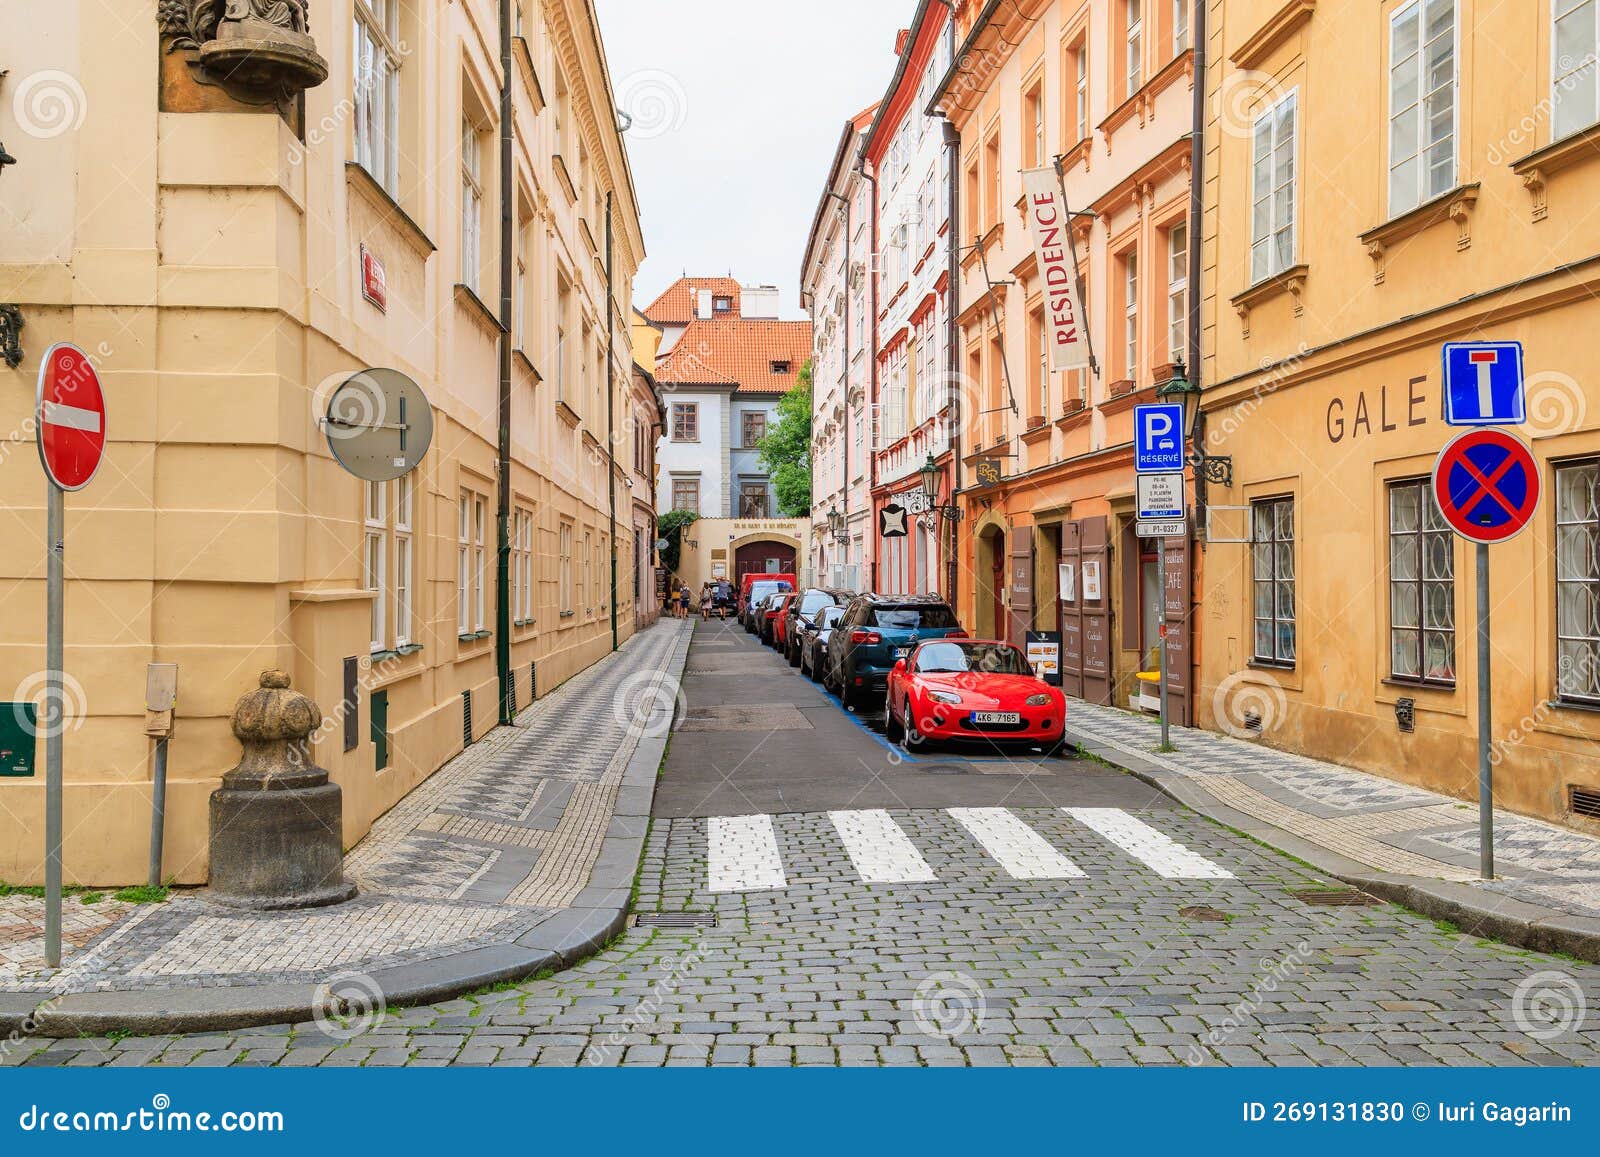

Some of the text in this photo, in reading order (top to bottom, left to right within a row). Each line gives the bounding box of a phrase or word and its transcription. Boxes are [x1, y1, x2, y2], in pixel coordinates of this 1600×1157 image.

[1033, 191, 1078, 345] RESIDENCE
[1140, 452, 1179, 463] RÉSERVÉ
[977, 713, 1016, 722] 4K6 7165
